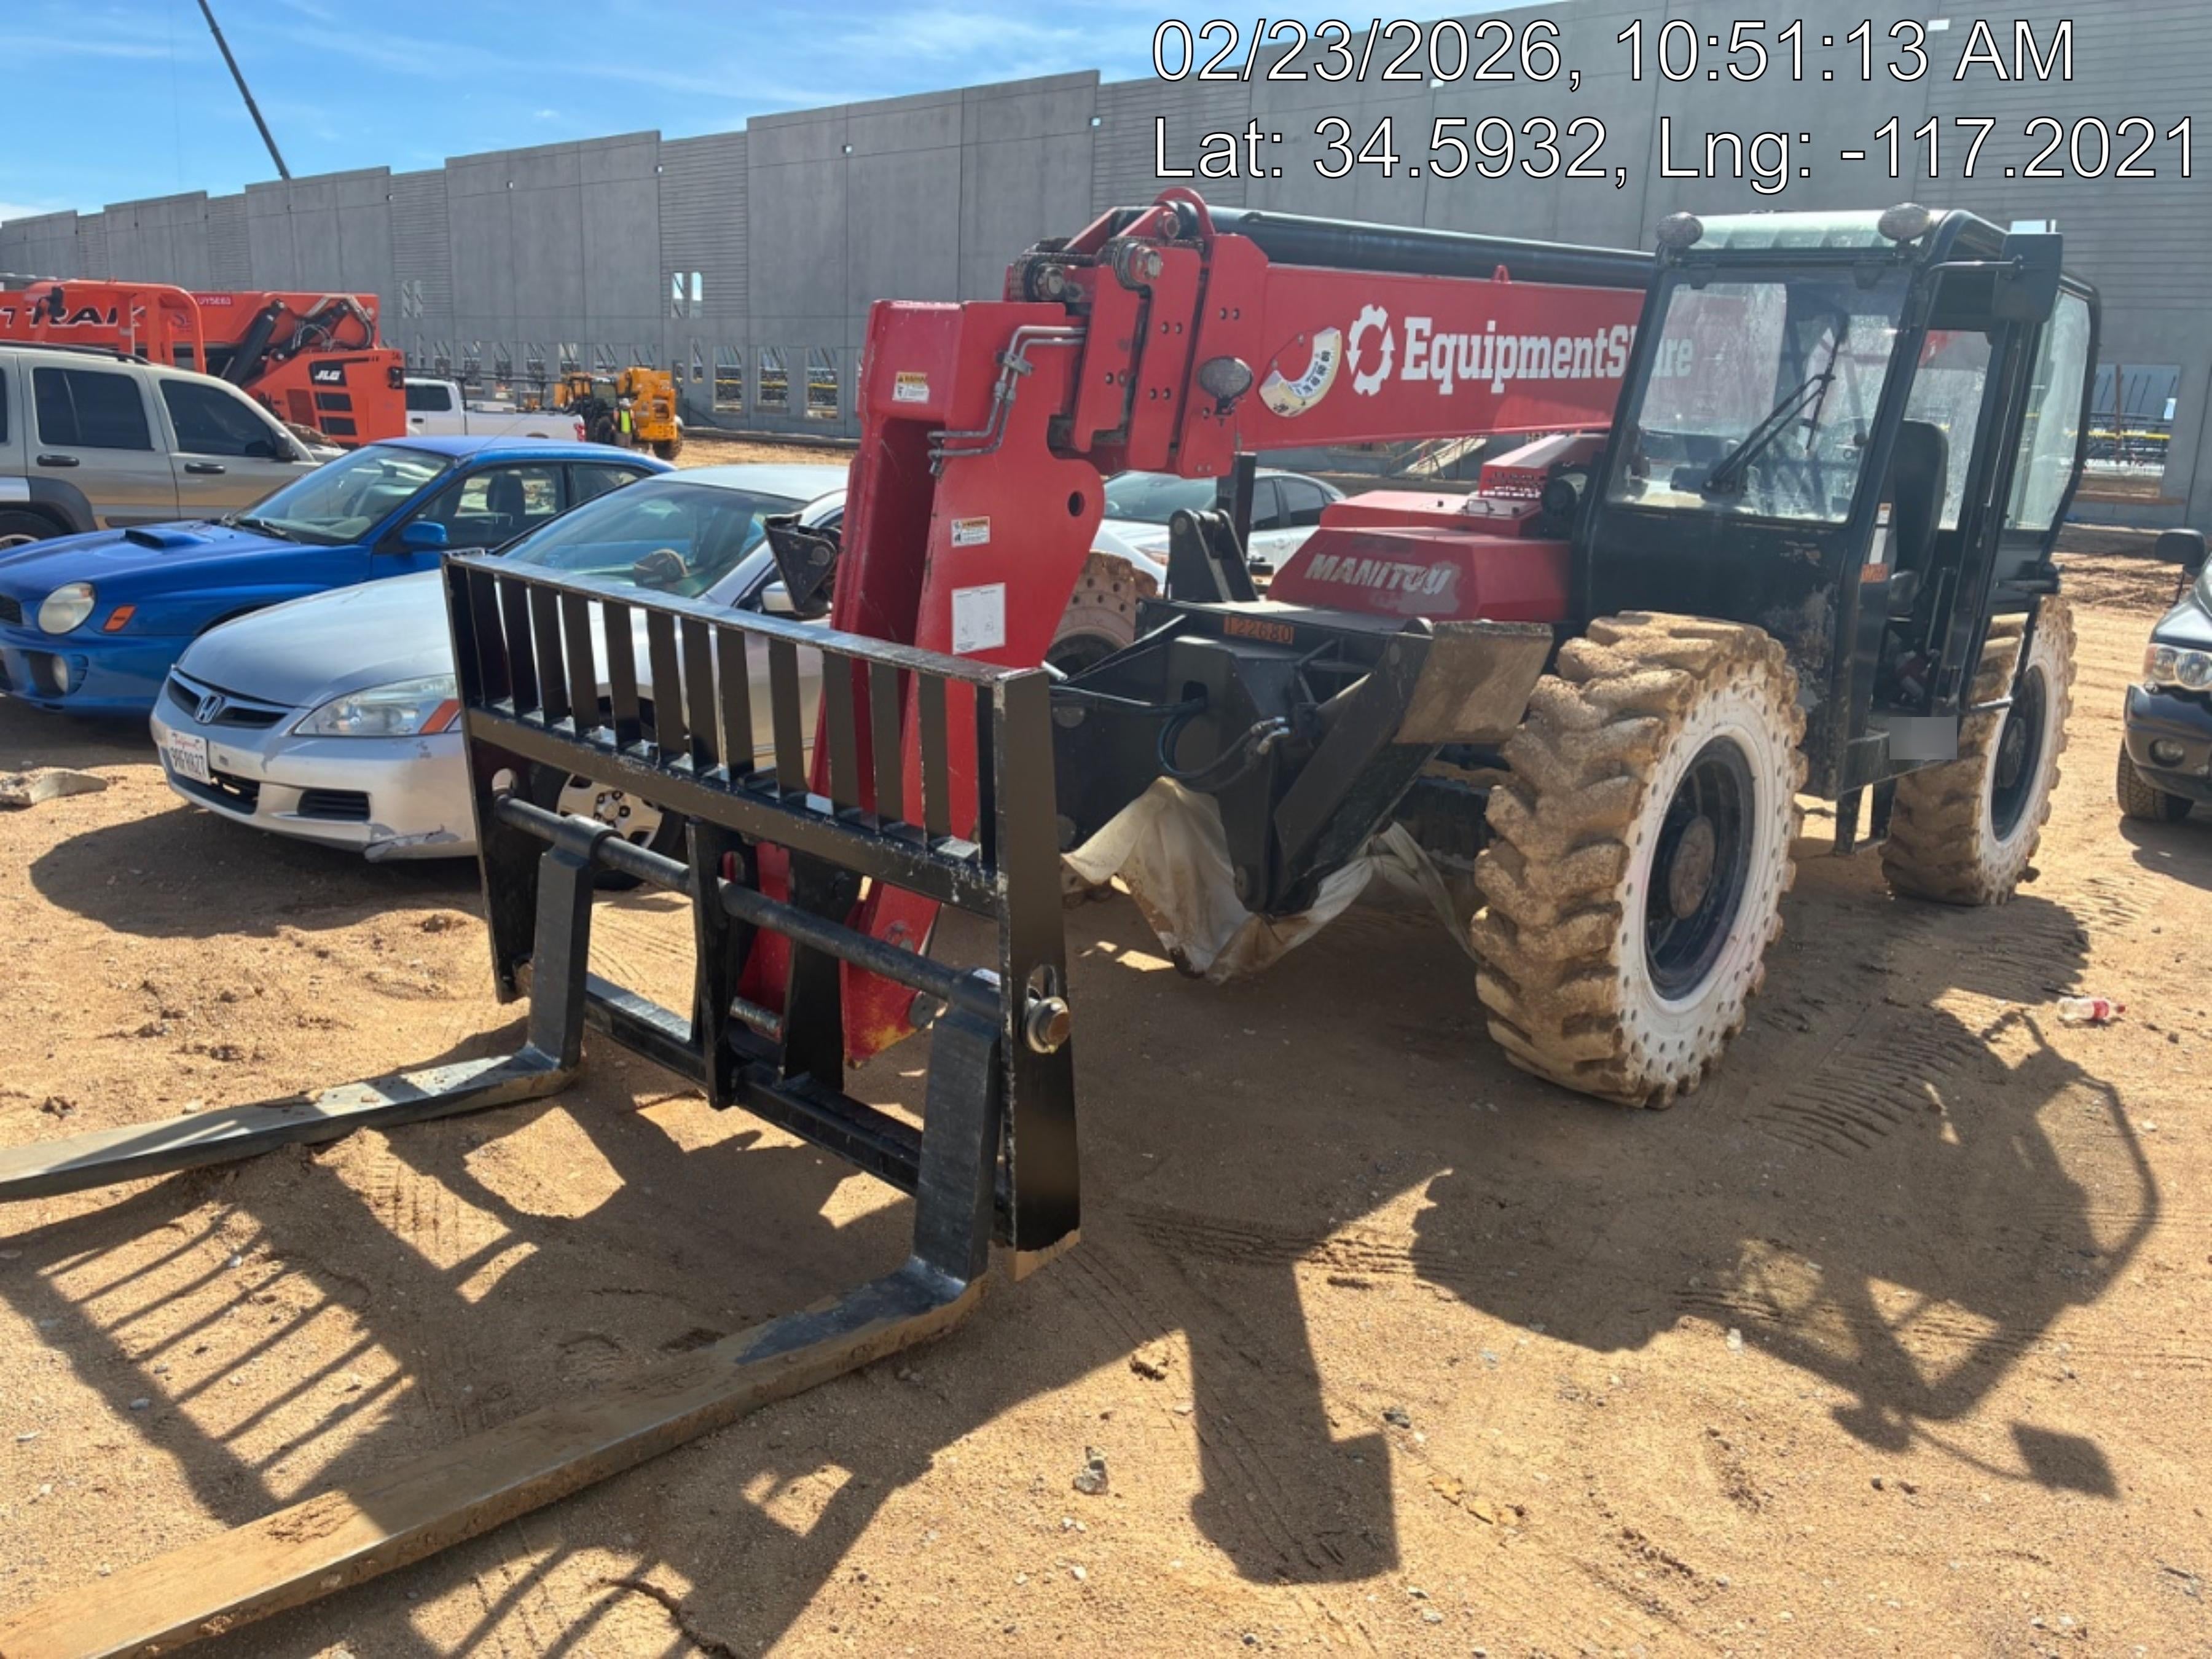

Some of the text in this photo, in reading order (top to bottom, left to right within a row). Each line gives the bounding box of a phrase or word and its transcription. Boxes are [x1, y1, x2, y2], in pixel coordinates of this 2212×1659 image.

[315, 370, 341, 380] JLG
[1400, 316, 1694, 394] EquipmentSre
[1304, 554, 1452, 595] MANITOU
